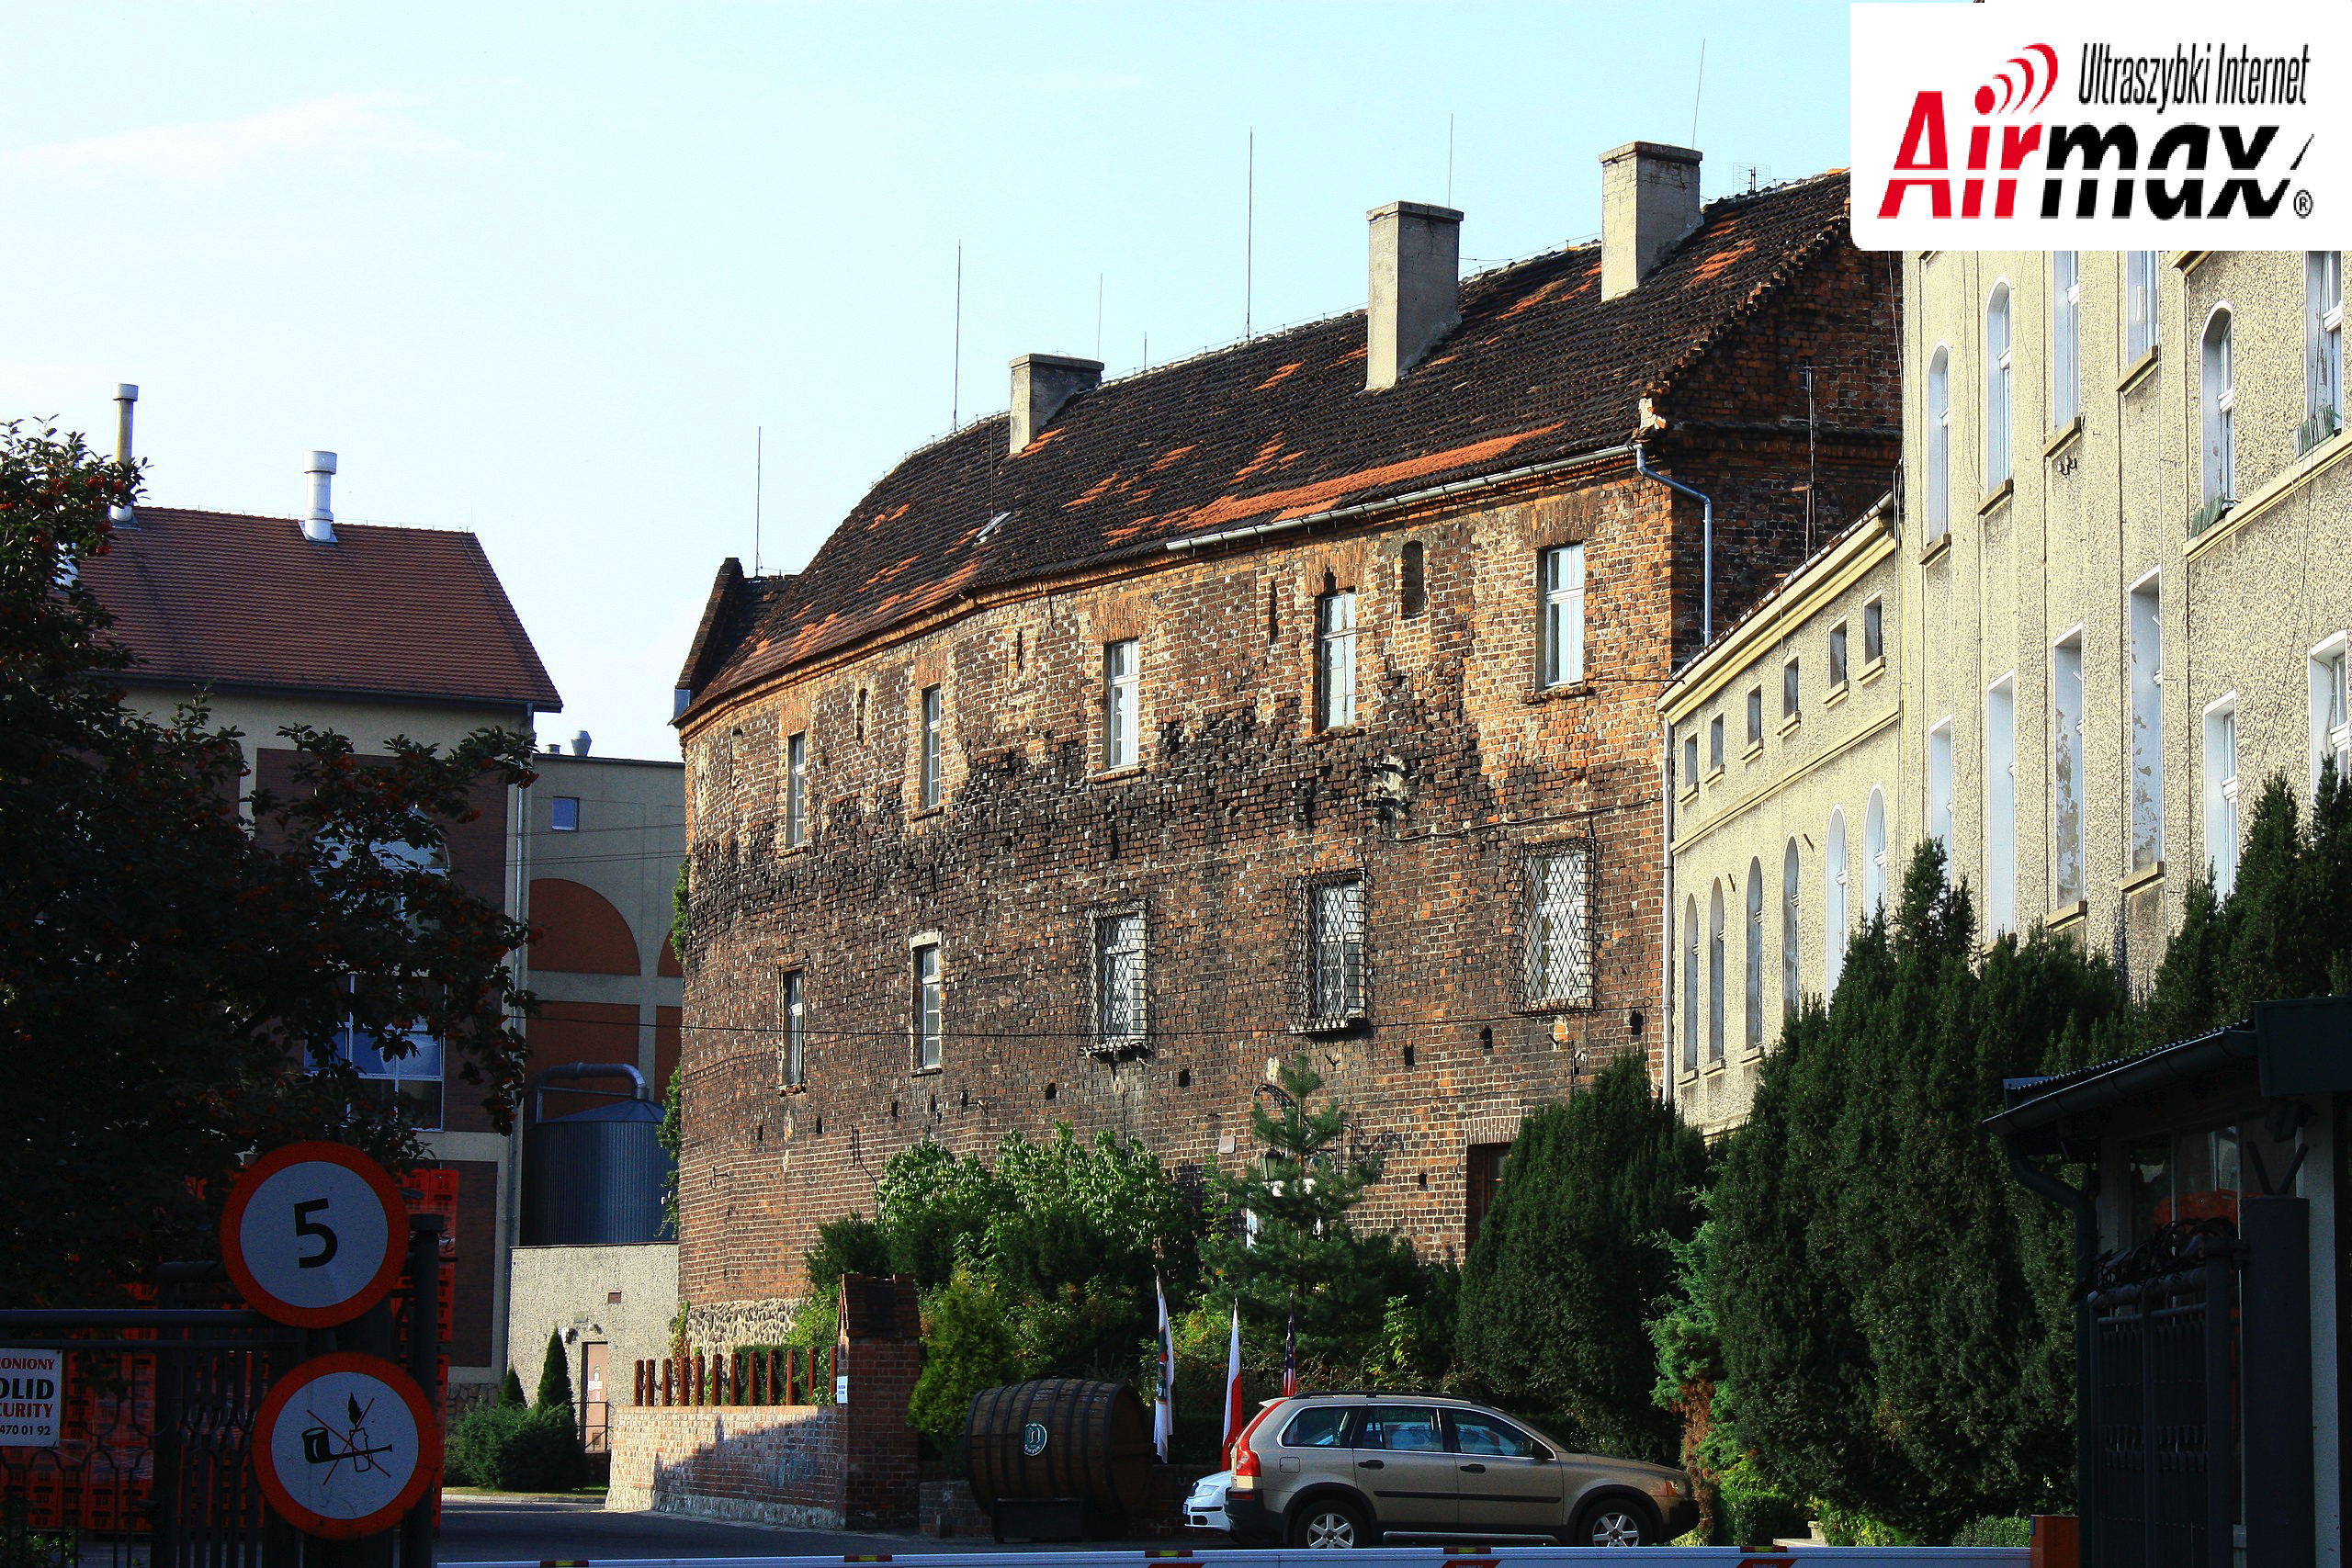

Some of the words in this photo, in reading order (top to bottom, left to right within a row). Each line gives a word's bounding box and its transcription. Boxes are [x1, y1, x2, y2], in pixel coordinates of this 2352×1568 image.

[293, 1197, 339, 1269] 5
[0, 1357, 55, 1371] ONIONY
[0, 1402, 54, 1418] URITY
[21, 1425, 33, 1436] 01
[38, 1425, 51, 1436] 92
